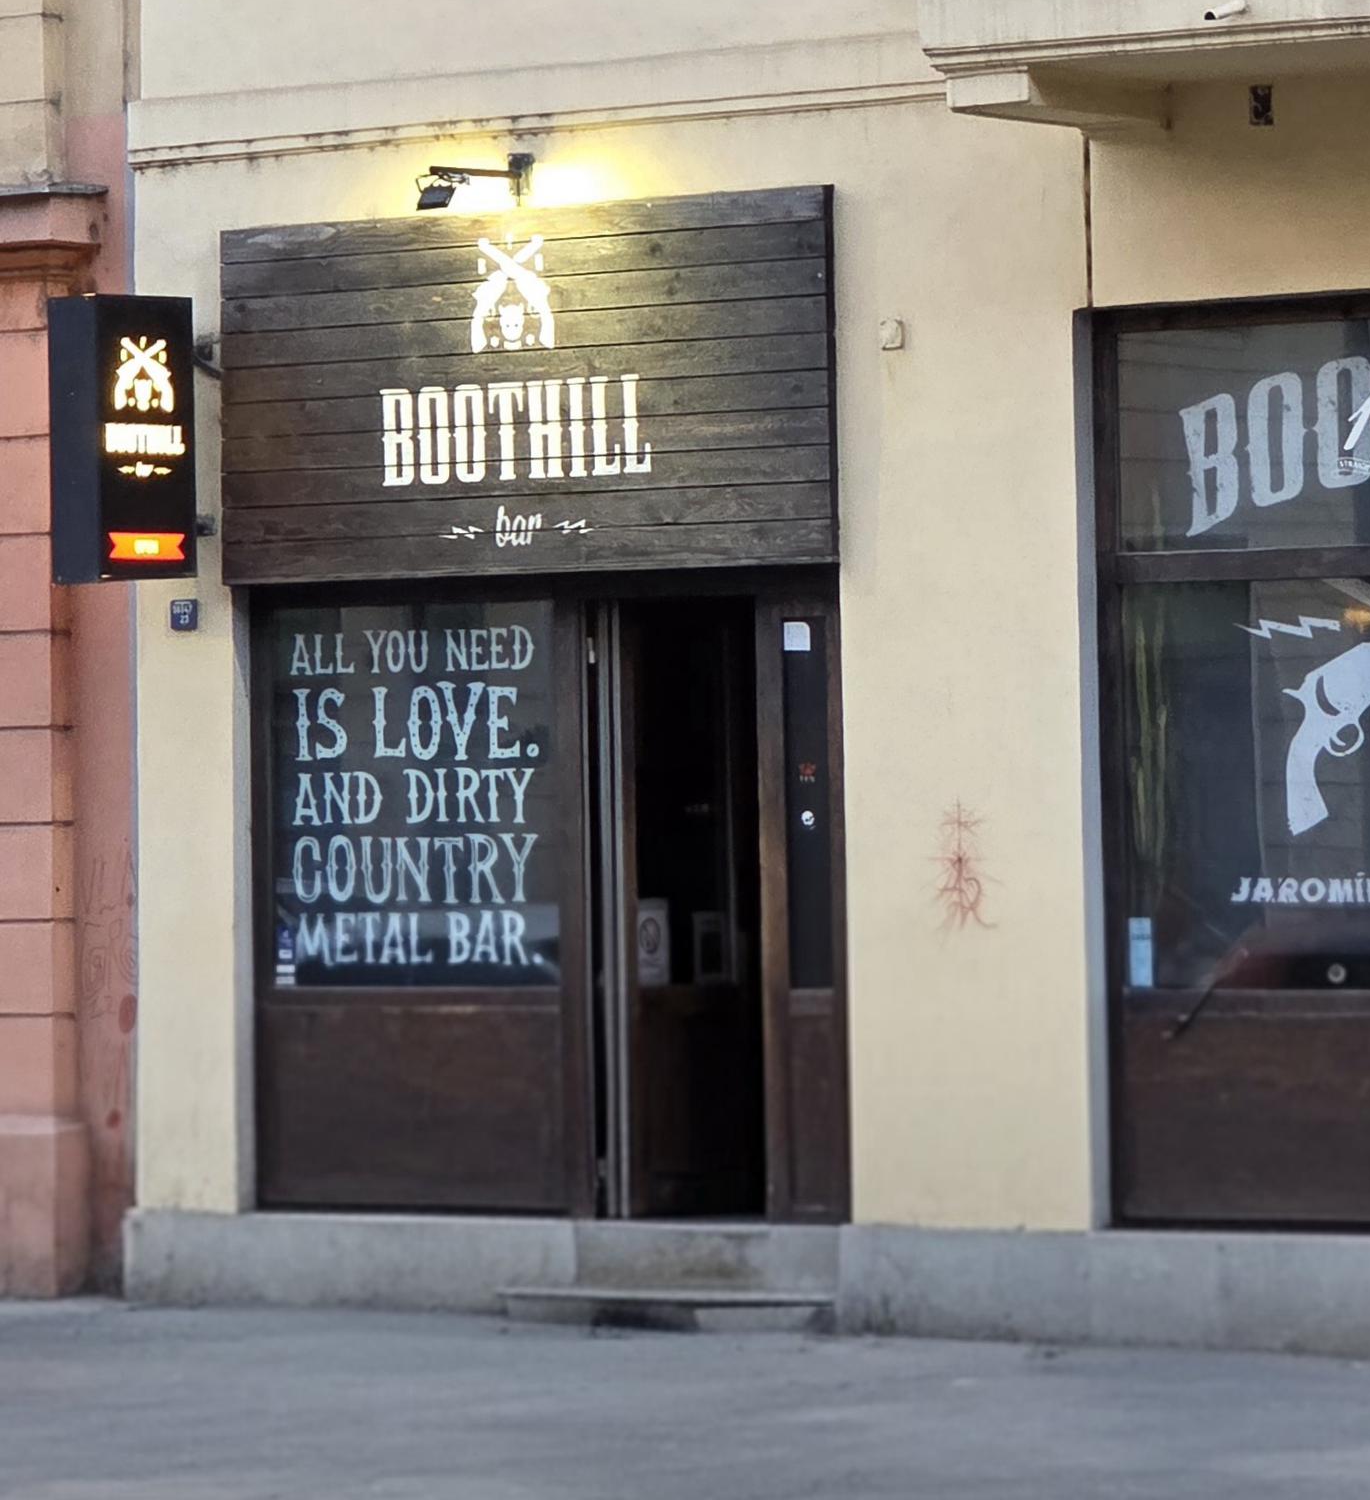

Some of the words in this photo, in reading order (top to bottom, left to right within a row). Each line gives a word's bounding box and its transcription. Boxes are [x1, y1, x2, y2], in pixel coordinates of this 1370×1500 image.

[379, 373, 652, 487] BOOTHILL
[495, 505, 543, 548] bar
[290, 633, 354, 675] ALL
[364, 629, 428, 672] YOU
[445, 625, 534, 671] NEED
[292, 688, 348, 761] IS
[372, 681, 540, 761] LOVE.
[292, 771, 382, 825] AND
[403, 768, 535, 824] DIRTY
[292, 833, 538, 903] COUNTRY
[294, 911, 432, 968] METAL
[447, 910, 544, 966] BAR.
